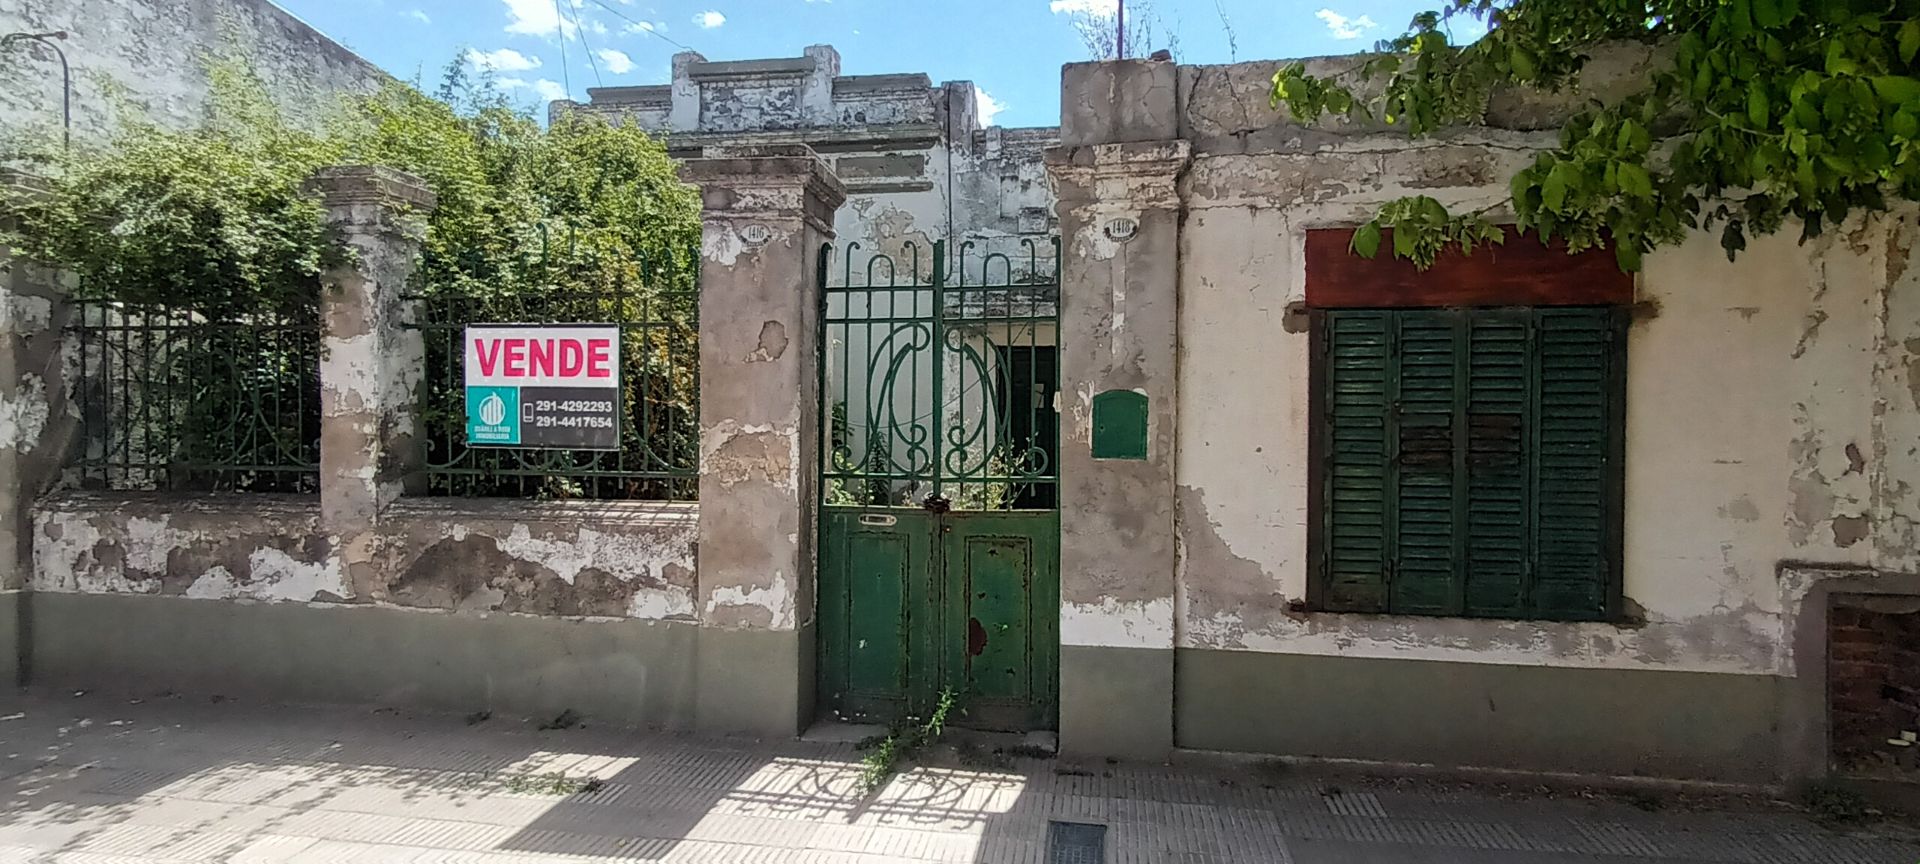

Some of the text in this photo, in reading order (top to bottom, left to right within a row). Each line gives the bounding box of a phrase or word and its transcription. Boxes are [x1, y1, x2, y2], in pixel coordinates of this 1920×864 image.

[748, 226, 765, 239] 1416
[1112, 220, 1131, 233] 1418
[474, 339, 611, 377] VENDE
[536, 400, 613, 413] 291-4292293
[536, 416, 613, 428] 291-4417654
